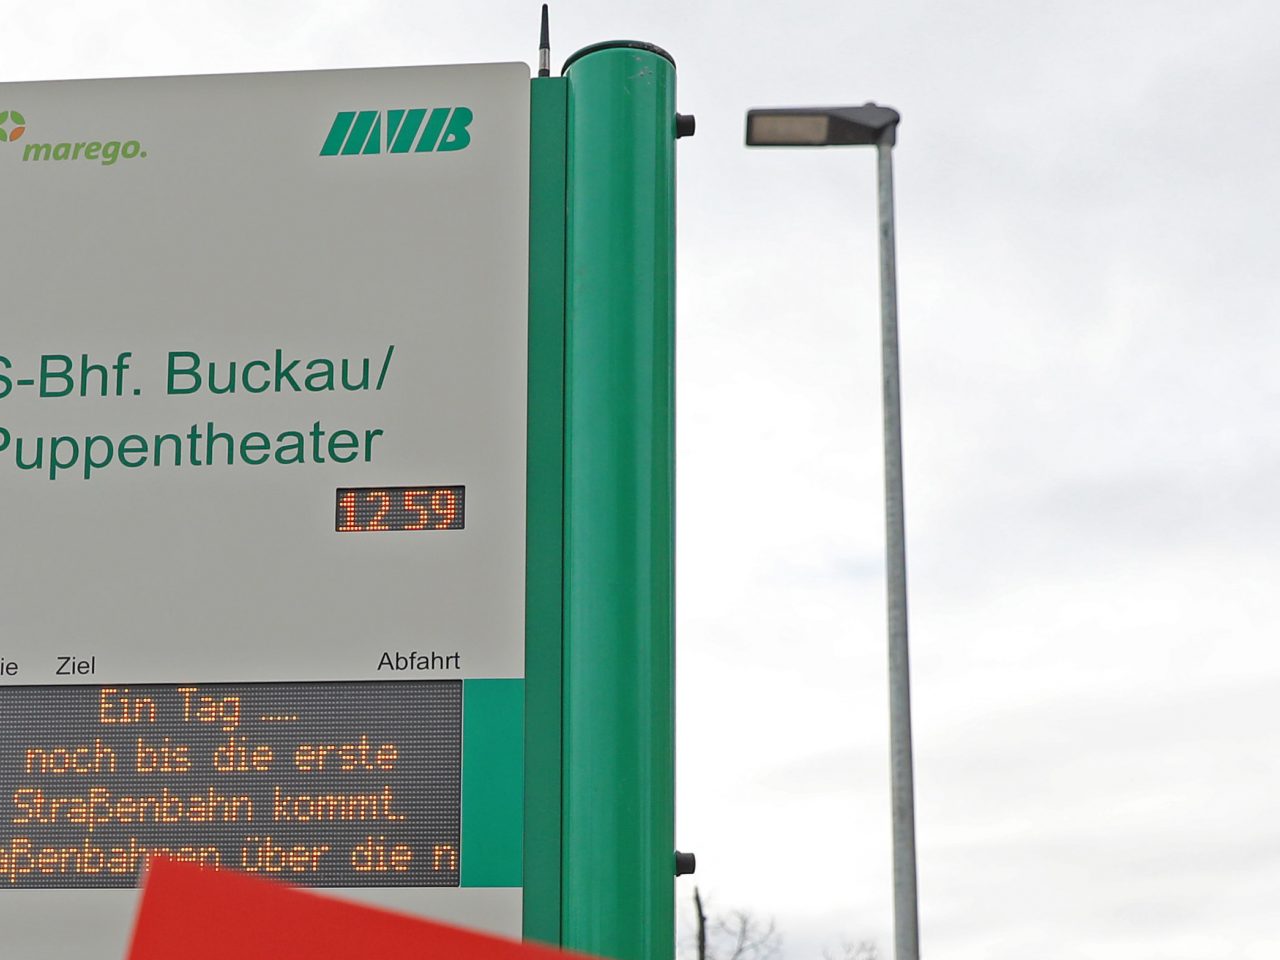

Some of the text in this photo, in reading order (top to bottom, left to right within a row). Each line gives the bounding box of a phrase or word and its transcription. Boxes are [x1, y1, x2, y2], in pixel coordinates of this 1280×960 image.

[22, 137, 148, 166] marego.
[319, 106, 474, 156] MVB
[166, 345, 396, 395] Buckau/
[56, 656, 96, 675] Ziel
[377, 651, 461, 671] Abfahrt
[97, 688, 156, 724] Ein
[178, 687, 241, 731] Tag
[24, 735, 398, 774] noch bis die erste
[12, 785, 406, 831] Straßenbahn kommt.
[240, 836, 332, 873] über
[350, 835, 413, 872] die
